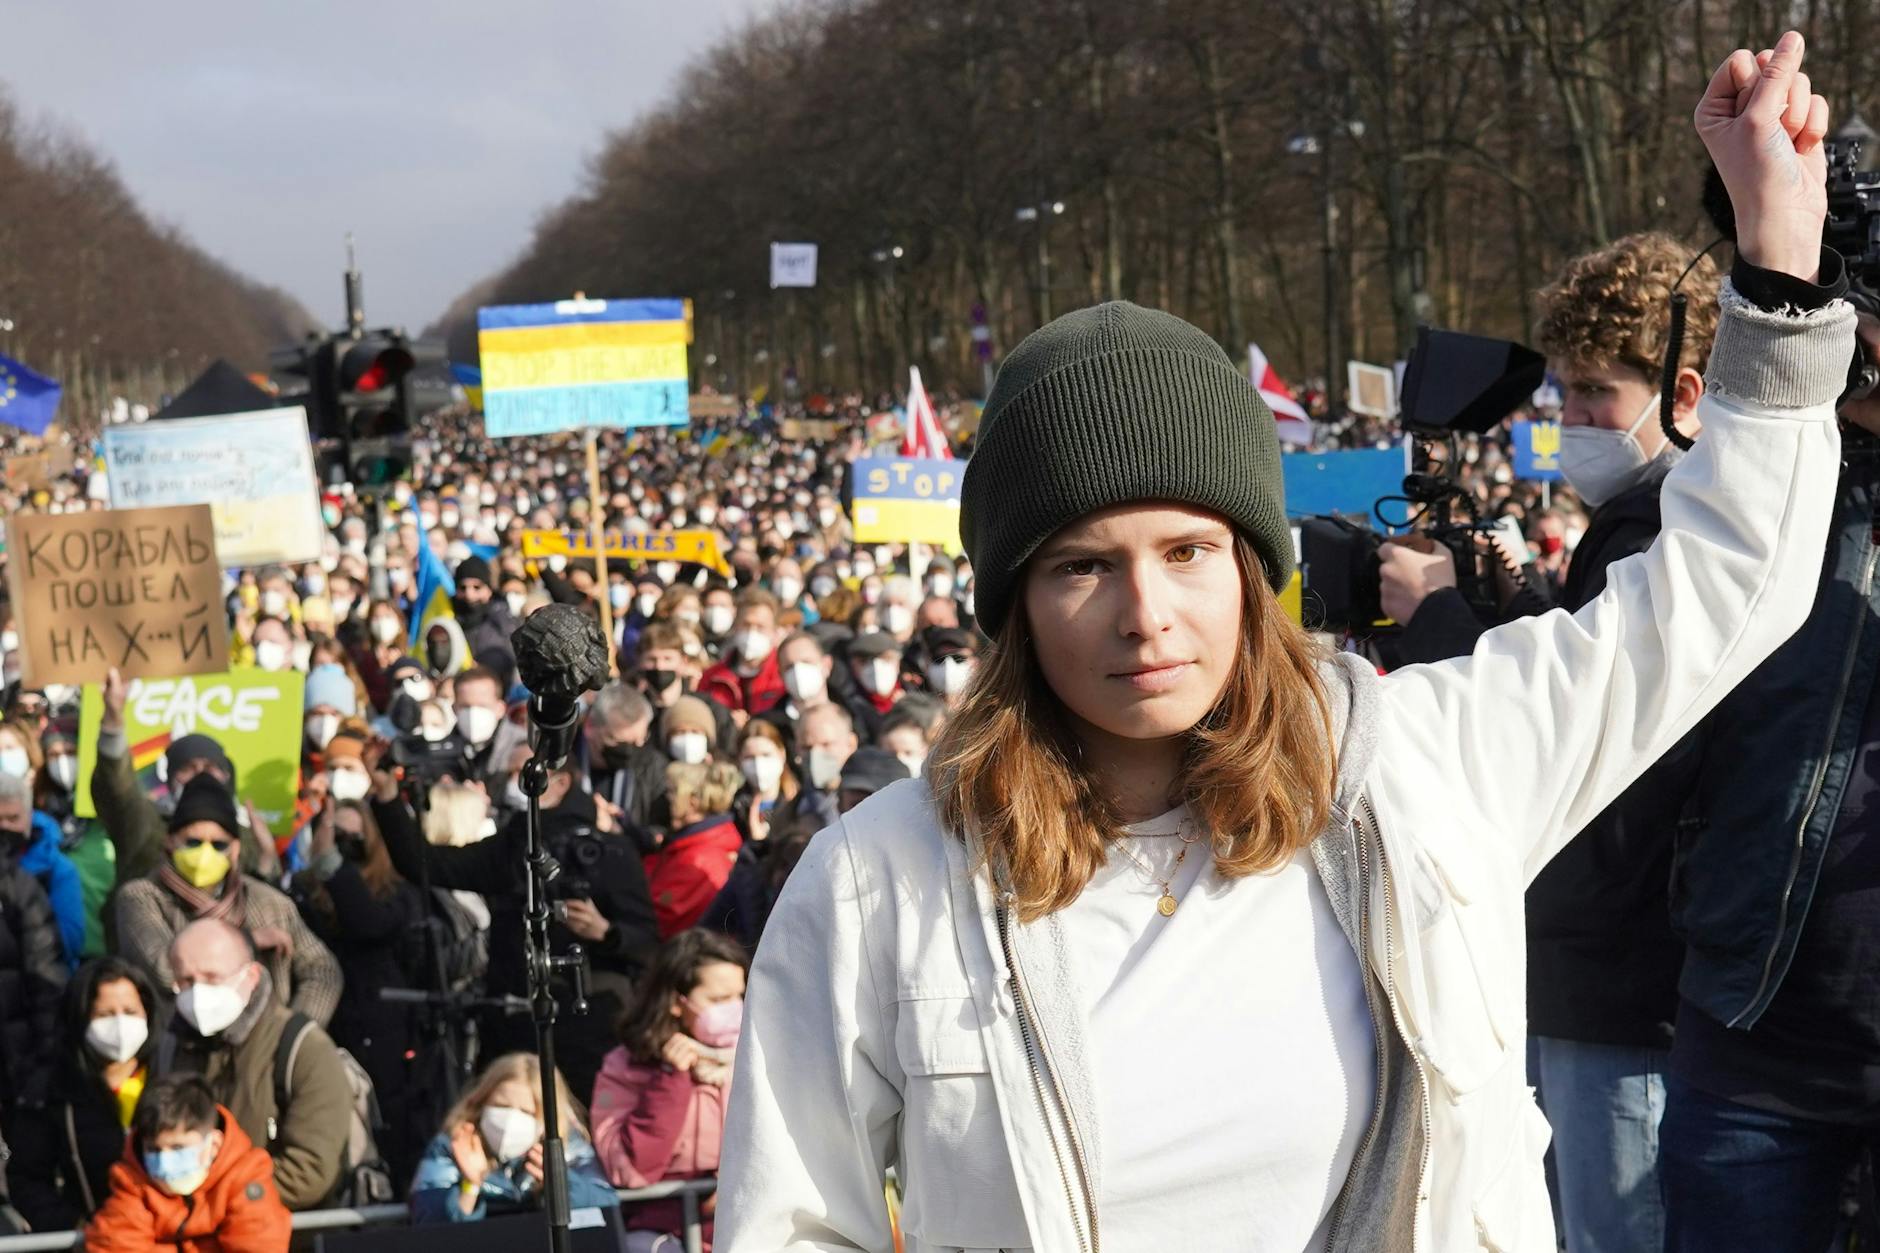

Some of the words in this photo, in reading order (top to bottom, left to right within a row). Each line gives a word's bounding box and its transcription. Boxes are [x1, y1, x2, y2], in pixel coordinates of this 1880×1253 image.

[489, 355, 554, 387] STOP
[567, 351, 609, 380] THE
[867, 462, 955, 497] STOP
[24, 524, 210, 578] КОРАБЛЬ
[51, 573, 191, 612] ПОШЕЛ
[49, 622, 107, 665] НА
